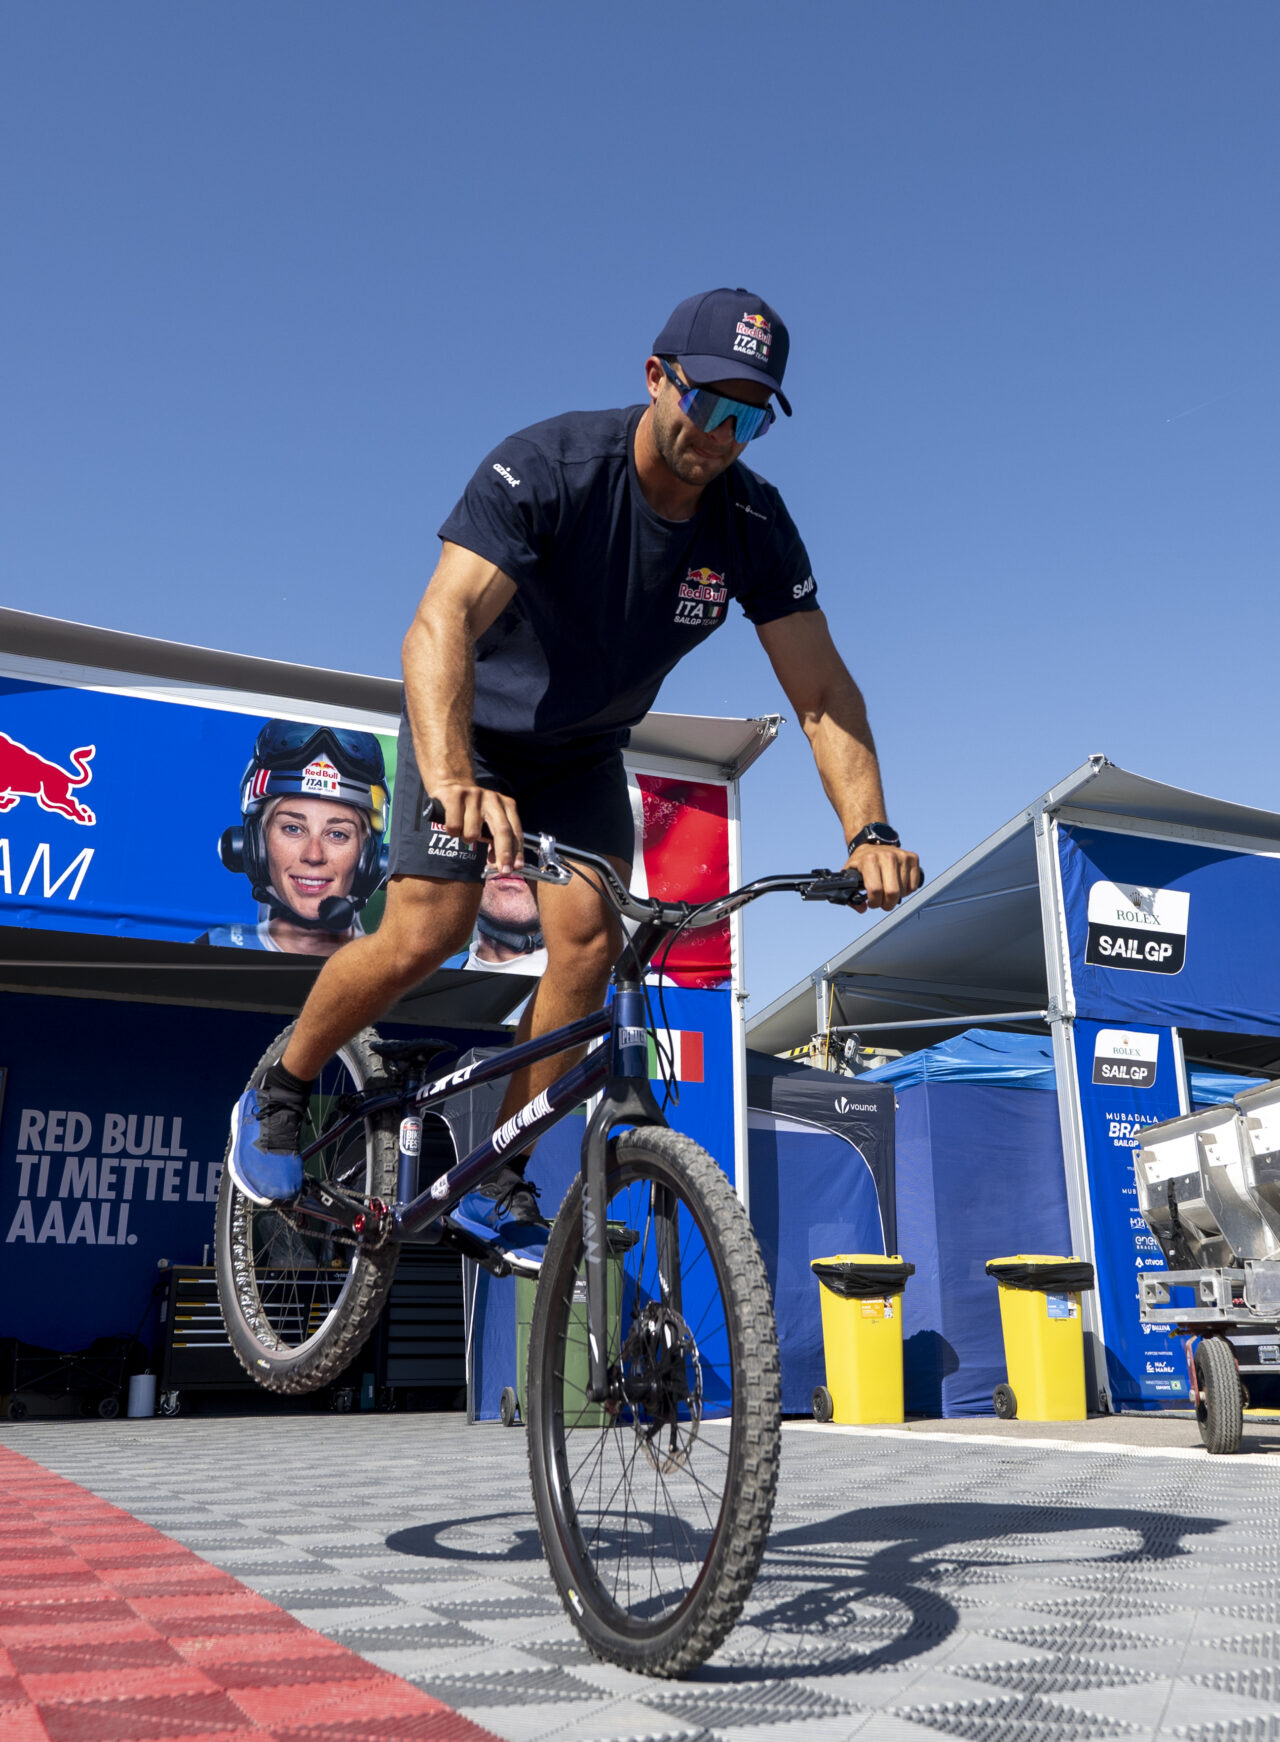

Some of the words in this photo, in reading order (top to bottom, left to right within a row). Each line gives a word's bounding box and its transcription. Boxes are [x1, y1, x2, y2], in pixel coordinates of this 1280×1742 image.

[734, 334, 757, 350] ITA
[493, 463, 520, 488] azimut
[675, 600, 704, 618] ITA
[673, 616, 702, 625] SAILGP
[305, 778, 322, 787] ITA
[428, 833, 460, 850] ITA
[427, 847, 458, 858] SAILGP
[459, 851, 478, 860] TEAM
[1116, 909, 1161, 925] ROLEX
[1112, 1047, 1141, 1057] ROLEX
[850, 1103, 877, 1112] vounot
[1105, 1112, 1159, 1123] MUBADALA
[17, 1109, 93, 1153] RED
[101, 1113, 188, 1157] BULL
[16, 1154, 51, 1198] TI
[58, 1156, 183, 1202] METTE
[5, 1200, 138, 1245] AAALI.
